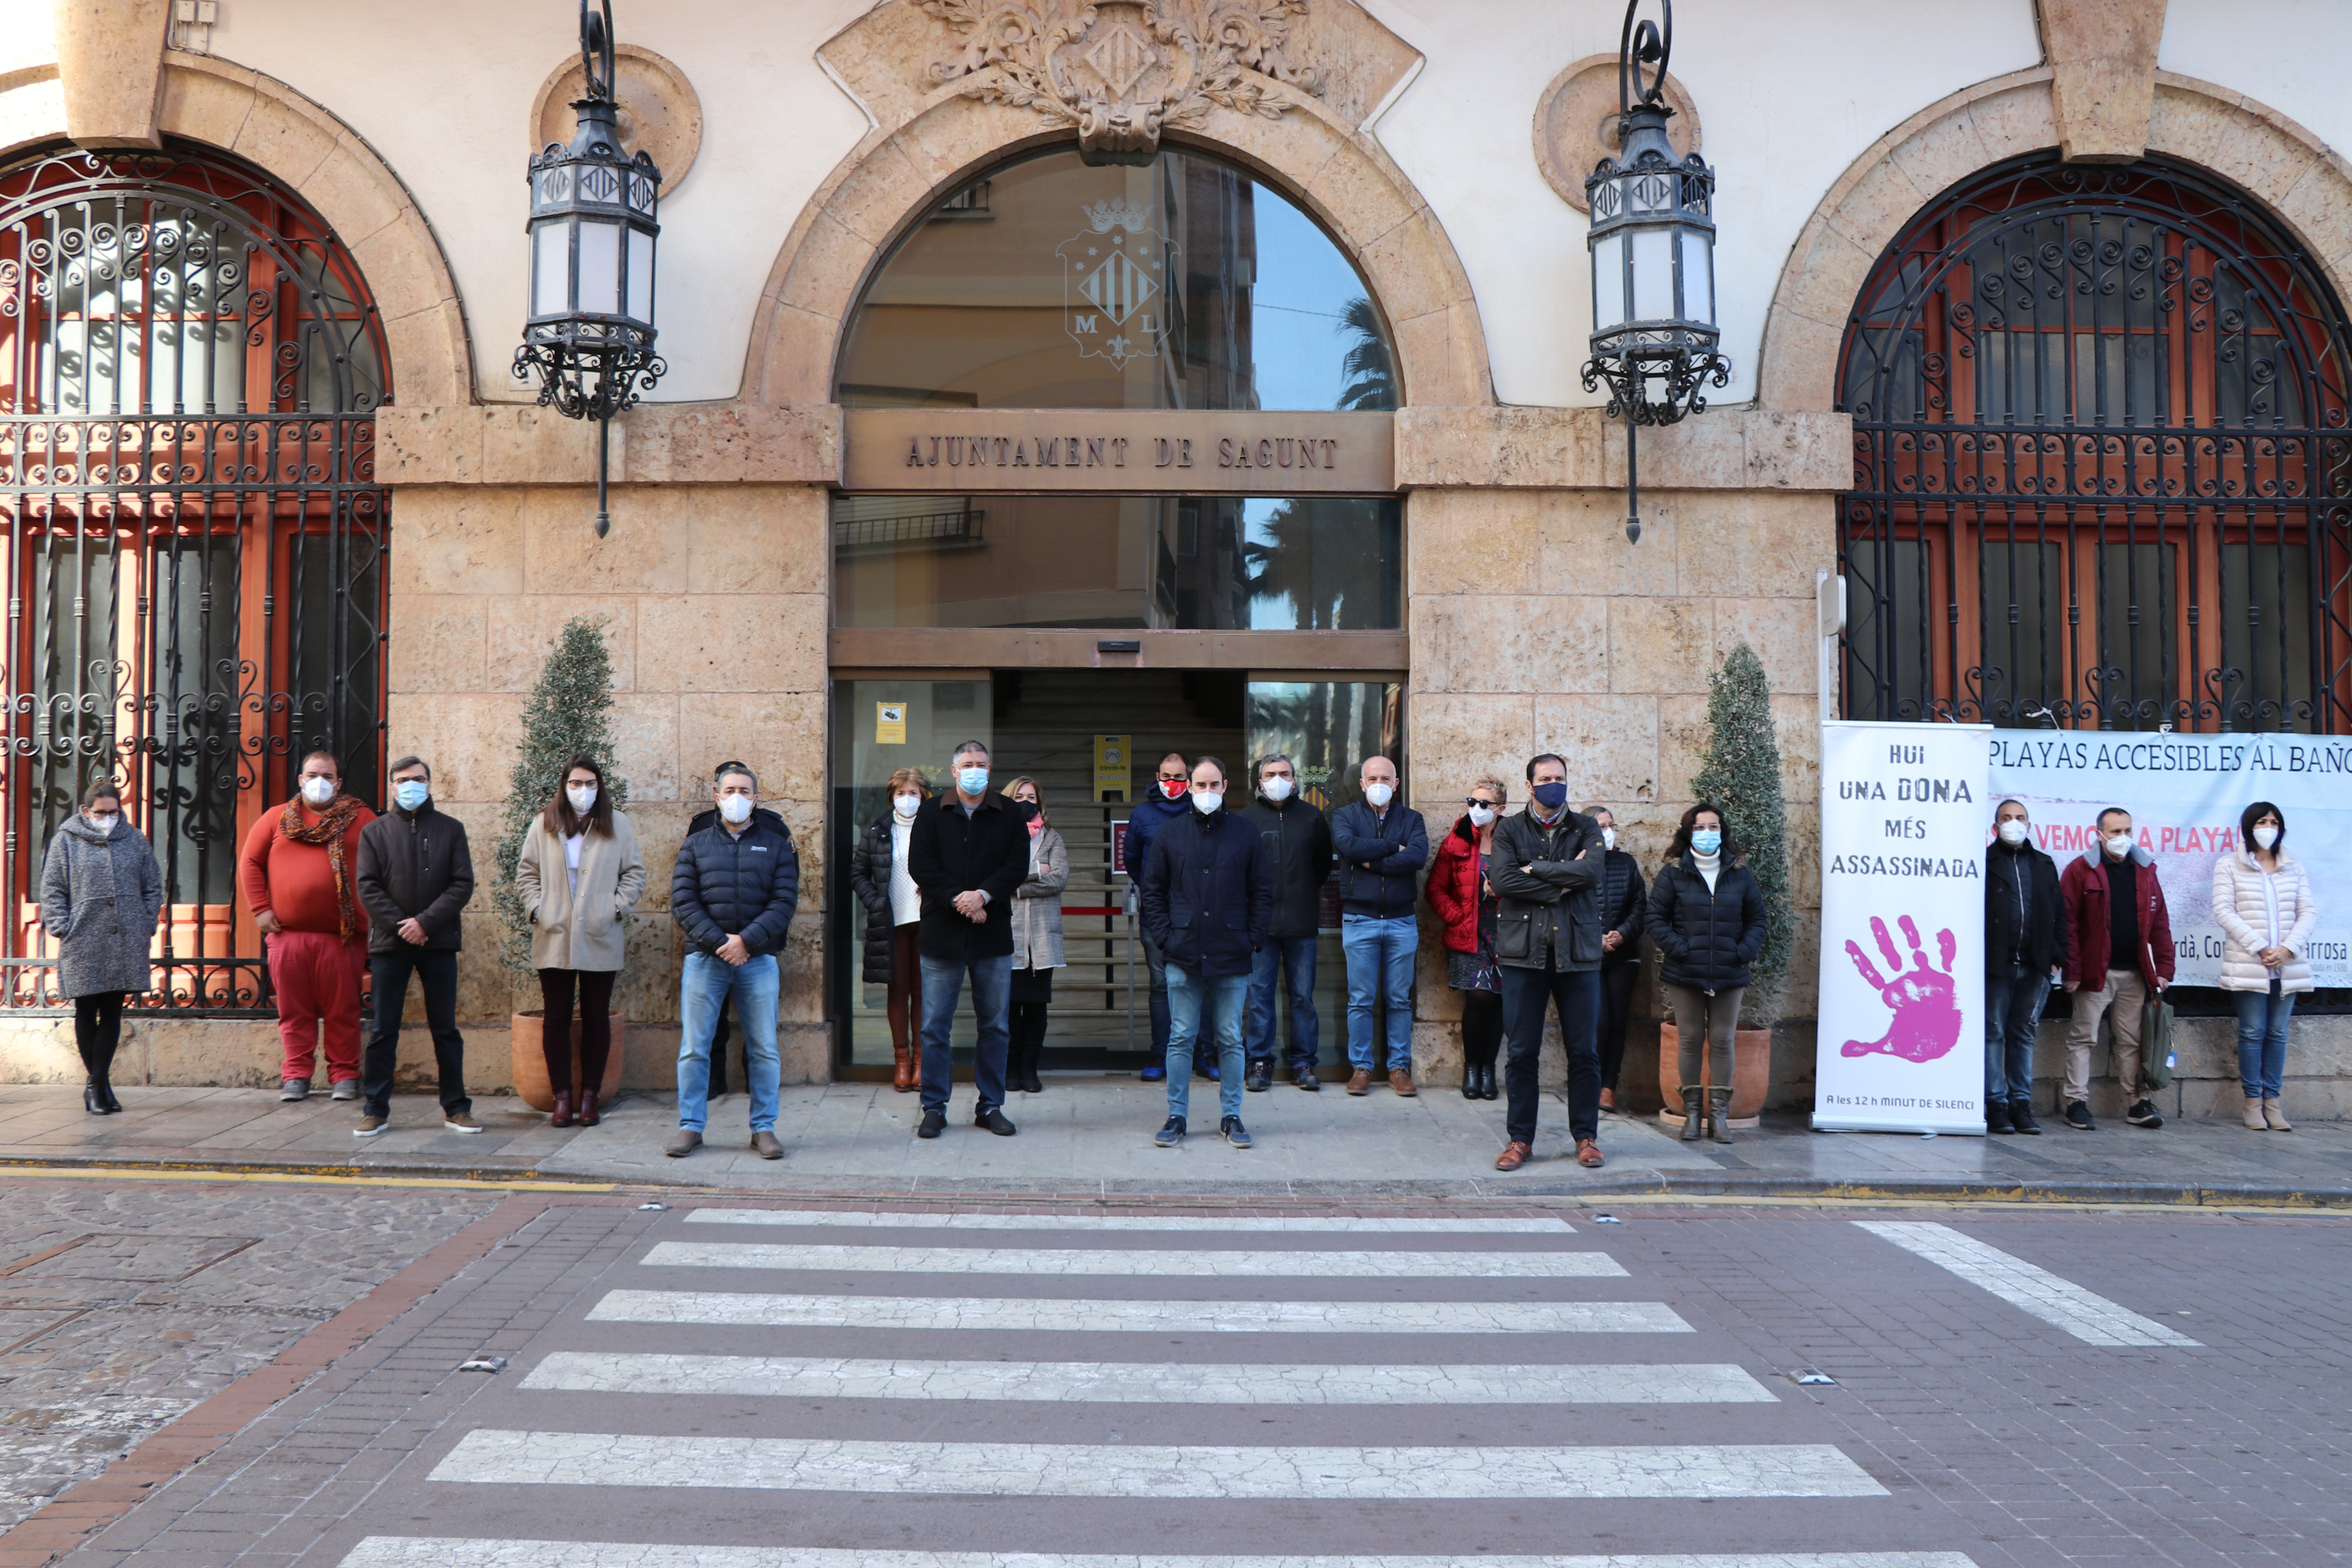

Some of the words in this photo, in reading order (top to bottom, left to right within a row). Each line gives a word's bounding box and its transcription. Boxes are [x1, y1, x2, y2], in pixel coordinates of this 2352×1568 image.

[1074, 315, 1098, 333] M
[1141, 315, 1160, 332] L
[907, 436, 1128, 466] AJUNTAMENT
[1154, 437, 1193, 466] DE
[1218, 437, 1337, 467] SAGUNT
[1889, 744, 1924, 764] HUI
[1989, 740, 2087, 769] PLAYAS
[2094, 743, 2245, 771] ACCESIBLES
[2250, 745, 2281, 771] AL
[1840, 781, 1886, 800] UNA
[1898, 778, 1973, 803] DONA
[1885, 816, 1926, 839] MÉS
[2161, 826, 2241, 853] PLAYA!
[1830, 855, 1979, 878] ASSASSINADA
[2174, 934, 2200, 961] rdà,
[2305, 942, 2347, 960] arrosa
[2333, 962, 2347, 972] 1986
[1826, 1095, 1834, 1103] A
[1837, 1095, 1851, 1105] les
[1855, 1096, 1867, 1105] 12
[1871, 1096, 1877, 1106] h
[1880, 1097, 1916, 1107] MINUT
[1919, 1099, 1933, 1108] DE
[1935, 1100, 1974, 1110] SILENCI
